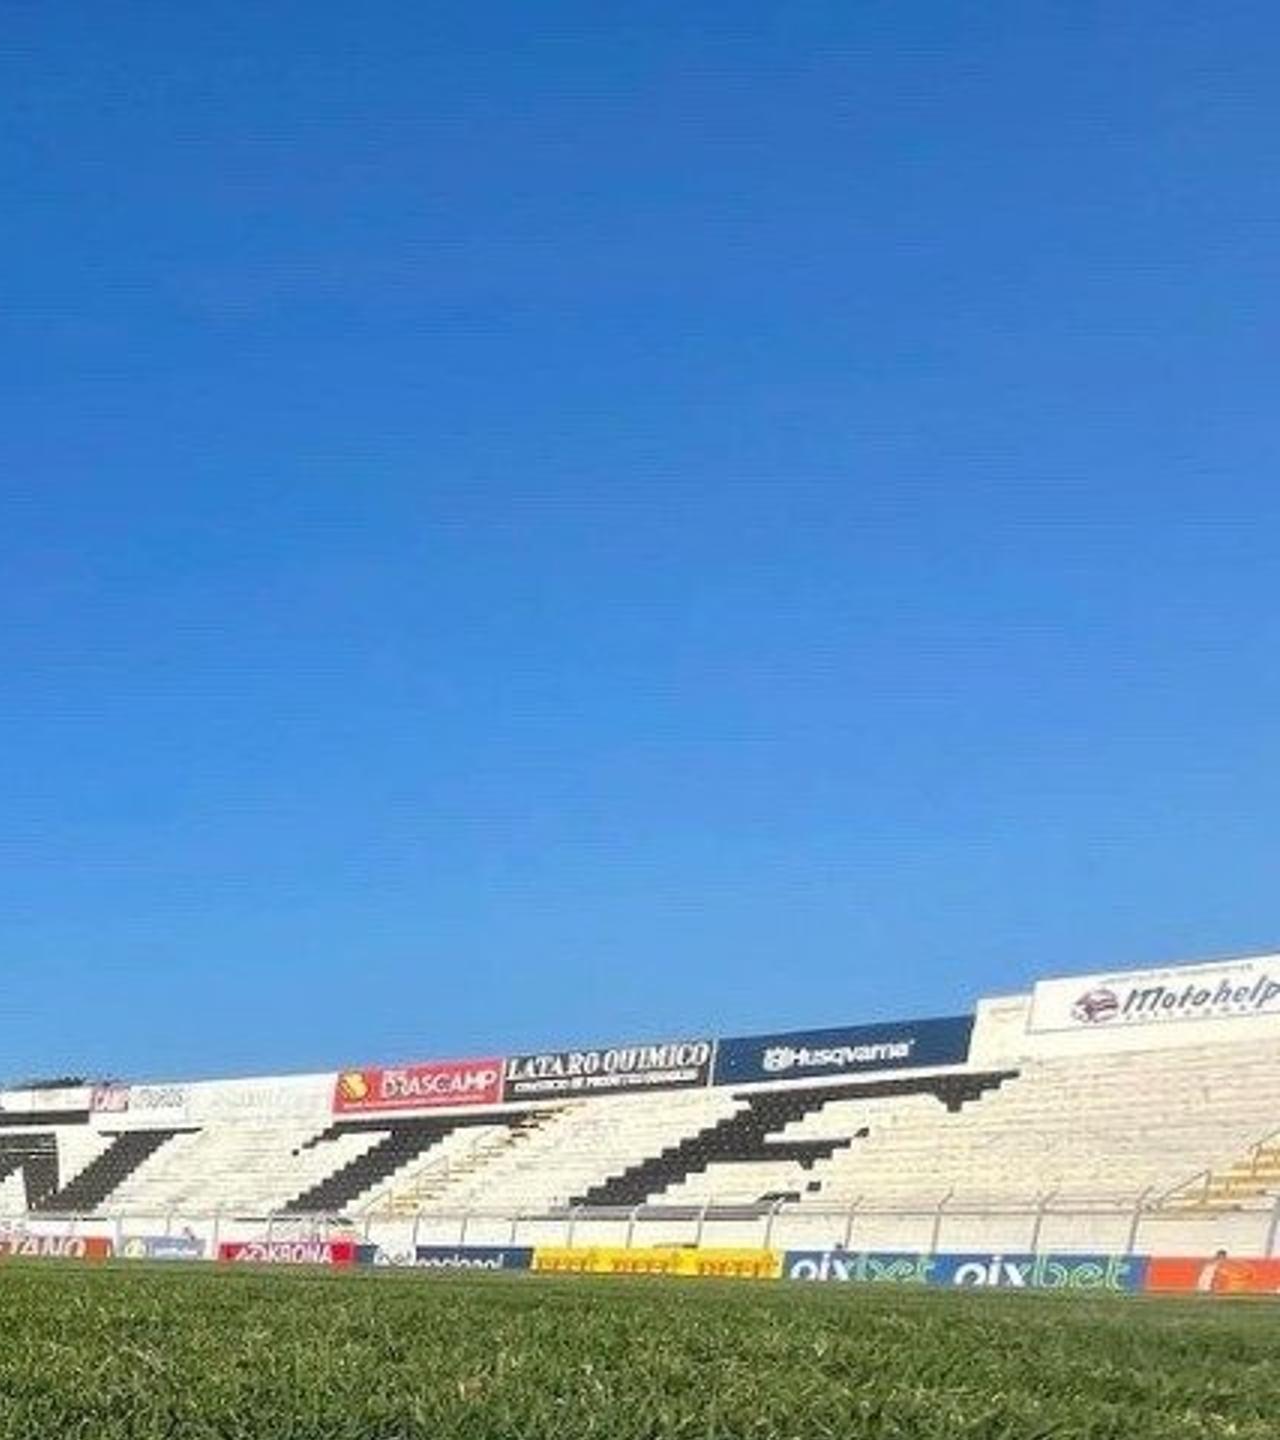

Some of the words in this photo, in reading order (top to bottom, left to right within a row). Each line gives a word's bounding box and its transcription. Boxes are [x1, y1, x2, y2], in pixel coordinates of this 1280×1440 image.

[1122, 976, 1280, 1014] Motohelp
[791, 1043, 910, 1067] Husqvarna
[791, 1252, 934, 1281] pixbet
[954, 1254, 1131, 1289] pixbet
